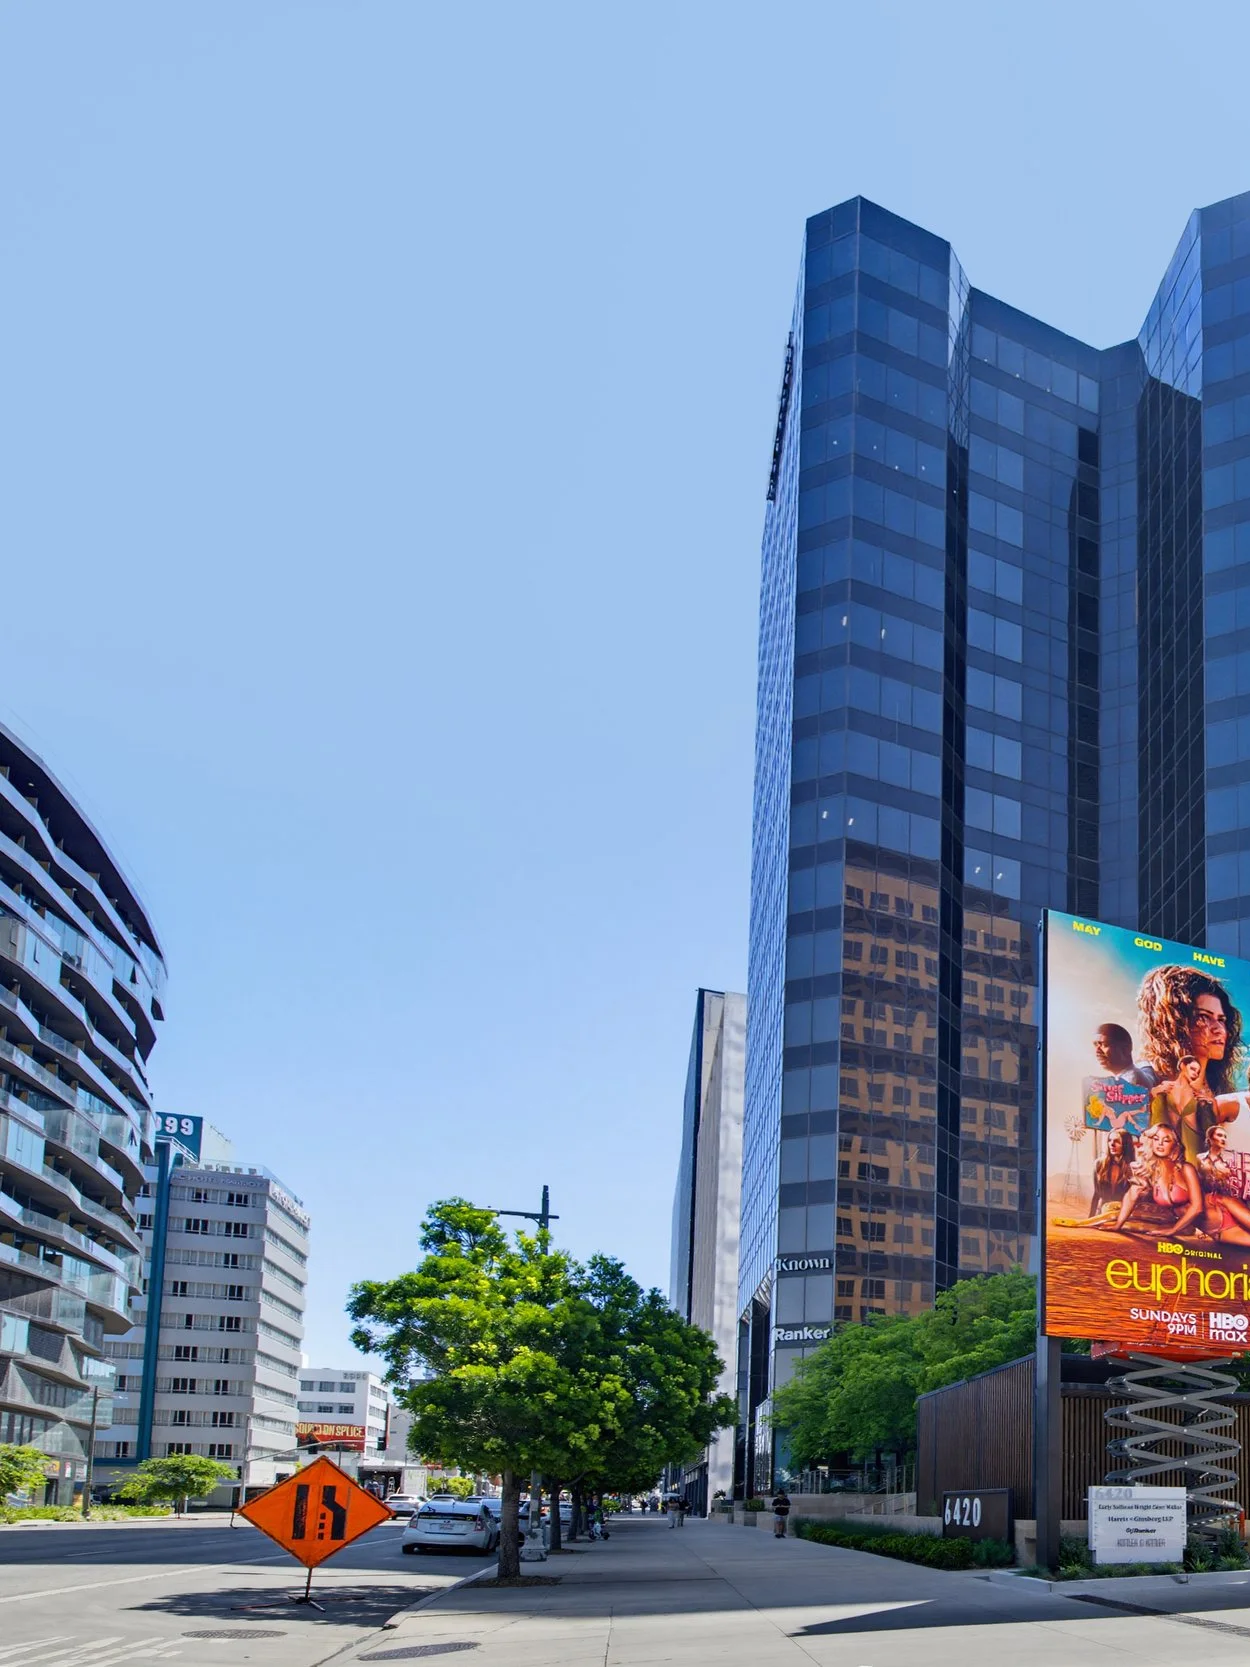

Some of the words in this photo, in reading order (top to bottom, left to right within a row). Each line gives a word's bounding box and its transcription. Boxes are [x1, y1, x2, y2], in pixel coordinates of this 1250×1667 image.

[1072, 921, 1101, 936] MAY
[1134, 937, 1163, 951] GOD
[1193, 952, 1226, 967] HAVE
[1157, 1241, 1184, 1255] HBO
[1184, 1249, 1223, 1260] ORIGINAL
[775, 1257, 830, 1272] Known
[1130, 1308, 1197, 1325] SUNDAYS
[1209, 1312, 1249, 1331] HBO
[775, 1326, 831, 1341] Ranker
[1167, 1323, 1197, 1336] 9PM
[1209, 1329, 1248, 1343] max
[1095, 1487, 1133, 1500] 6420
[944, 1497, 982, 1527] 6420
